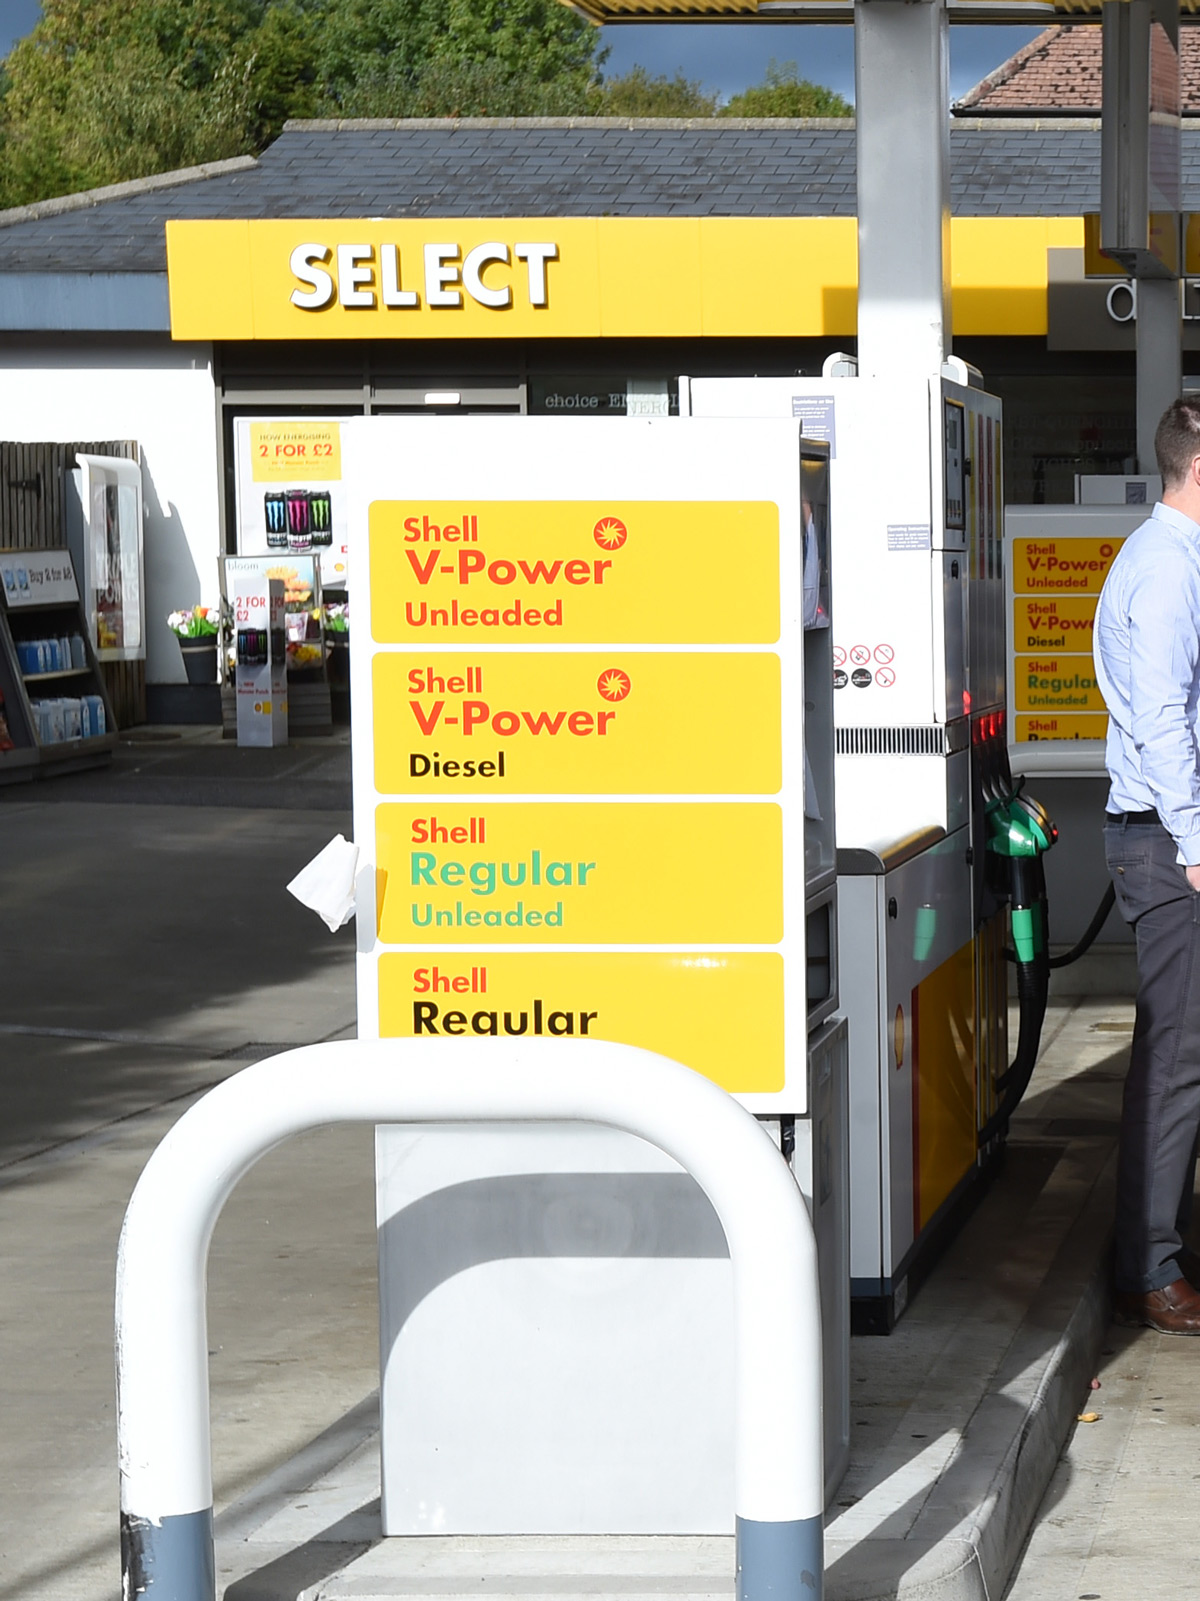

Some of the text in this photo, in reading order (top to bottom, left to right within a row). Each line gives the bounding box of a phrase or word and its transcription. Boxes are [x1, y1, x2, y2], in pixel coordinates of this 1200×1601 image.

[289, 242, 558, 309] SELECT
[545, 394, 598, 407] choice
[259, 443, 333, 457] 2 FOR £2
[403, 515, 478, 542] Shell
[1026, 543, 1055, 555] Shell
[405, 549, 612, 585] V-Power
[1027, 557, 1107, 572] V-Power
[1026, 577, 1088, 588] Unleaded
[236, 597, 242, 608] 2
[246, 597, 266, 608] FOR
[1027, 603, 1056, 614] Shell
[236, 611, 249, 622] £2
[405, 599, 563, 626] Unleaded
[1028, 616, 1094, 630] V-Pow
[1027, 636, 1065, 647] Diesel
[1028, 662, 1057, 673] Shell
[408, 667, 482, 693] Shell
[1028, 695, 1088, 705] Unleaded
[409, 701, 616, 736] V-Power
[1028, 720, 1057, 731] Shell
[410, 751, 505, 777] Diesel
[411, 817, 485, 844] Shell
[411, 850, 596, 895] Regular
[411, 901, 563, 927] Unleaded
[413, 966, 487, 993] Shell
